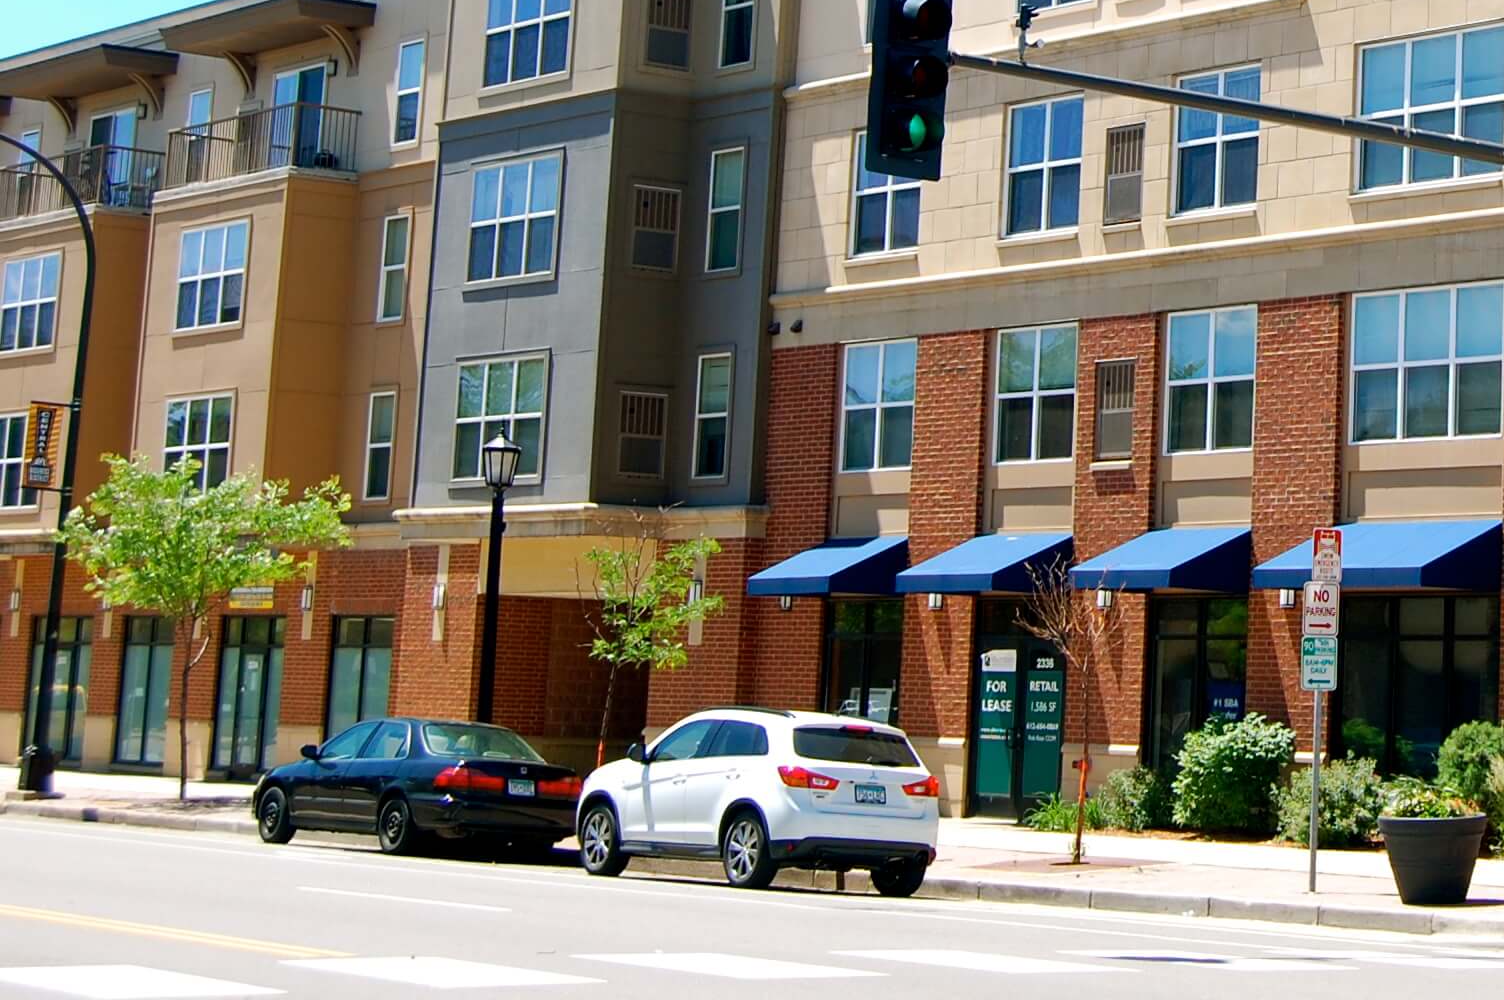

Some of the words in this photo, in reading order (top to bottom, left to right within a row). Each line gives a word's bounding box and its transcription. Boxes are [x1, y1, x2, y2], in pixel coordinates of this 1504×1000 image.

[1313, 590, 1330, 602] NO
[1306, 607, 1336, 617] PARKING
[986, 680, 1007, 693] FOR
[1029, 681, 1059, 692] RETAIL
[982, 699, 1013, 712] LEASE
